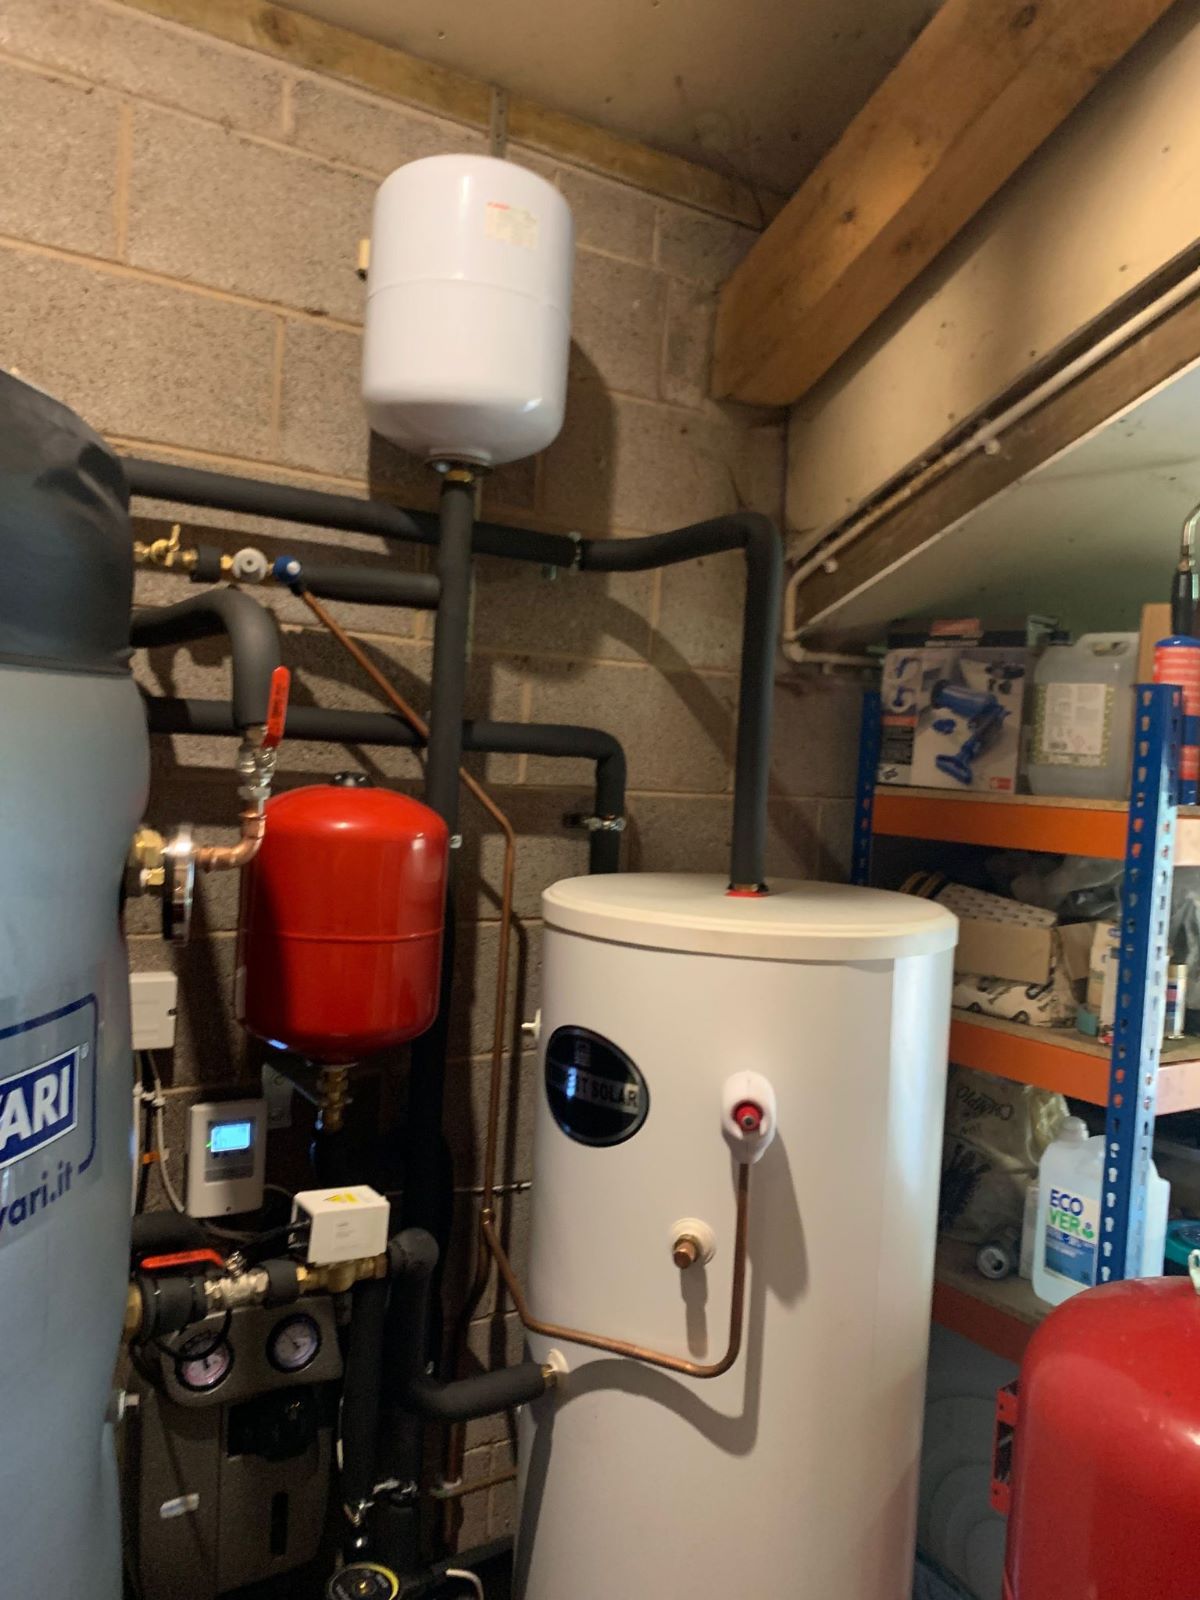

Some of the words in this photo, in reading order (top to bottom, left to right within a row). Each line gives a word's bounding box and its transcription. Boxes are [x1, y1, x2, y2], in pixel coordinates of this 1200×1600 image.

[0, 1064, 71, 1150] ARI
[1050, 1188, 1084, 1216] ECO
[1050, 1210, 1081, 1236] VER
